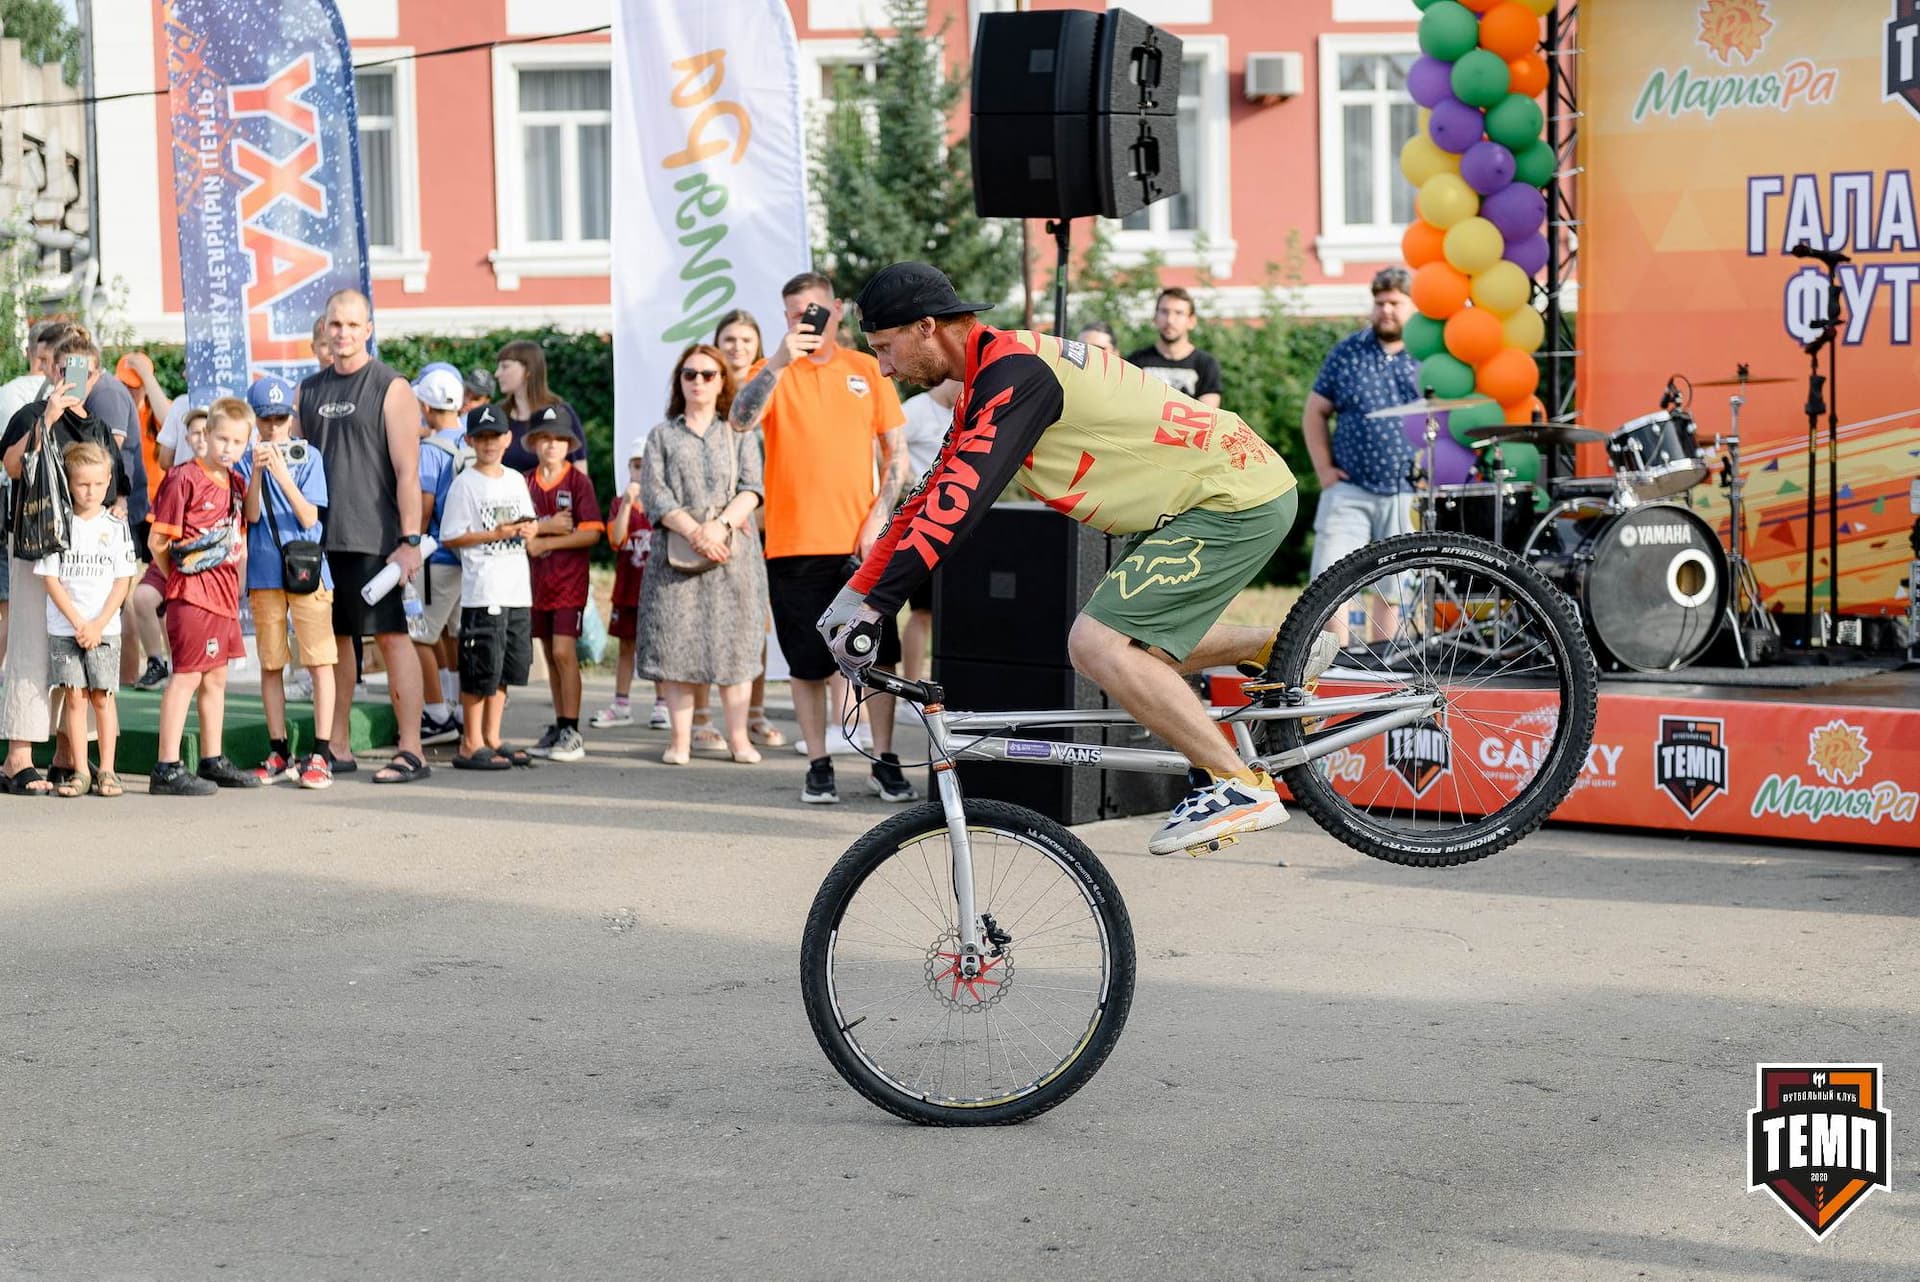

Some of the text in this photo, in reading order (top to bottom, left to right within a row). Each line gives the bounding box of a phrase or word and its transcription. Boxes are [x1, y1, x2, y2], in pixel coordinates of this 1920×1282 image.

[1634, 60, 1838, 121] МарияРа
[1637, 524, 1692, 545] YAMAHA
[63, 550, 113, 565] mirates
[1441, 546, 1495, 563] MICHELIN
[1054, 743, 1103, 764] VANS
[1391, 728, 1445, 762] ТЕМП
[1661, 745, 1722, 784] ТЕМП
[1752, 776, 1918, 823] МарияРа
[1038, 833, 1076, 862] MICHELIN
[1445, 833, 1498, 855] MICHELIN
